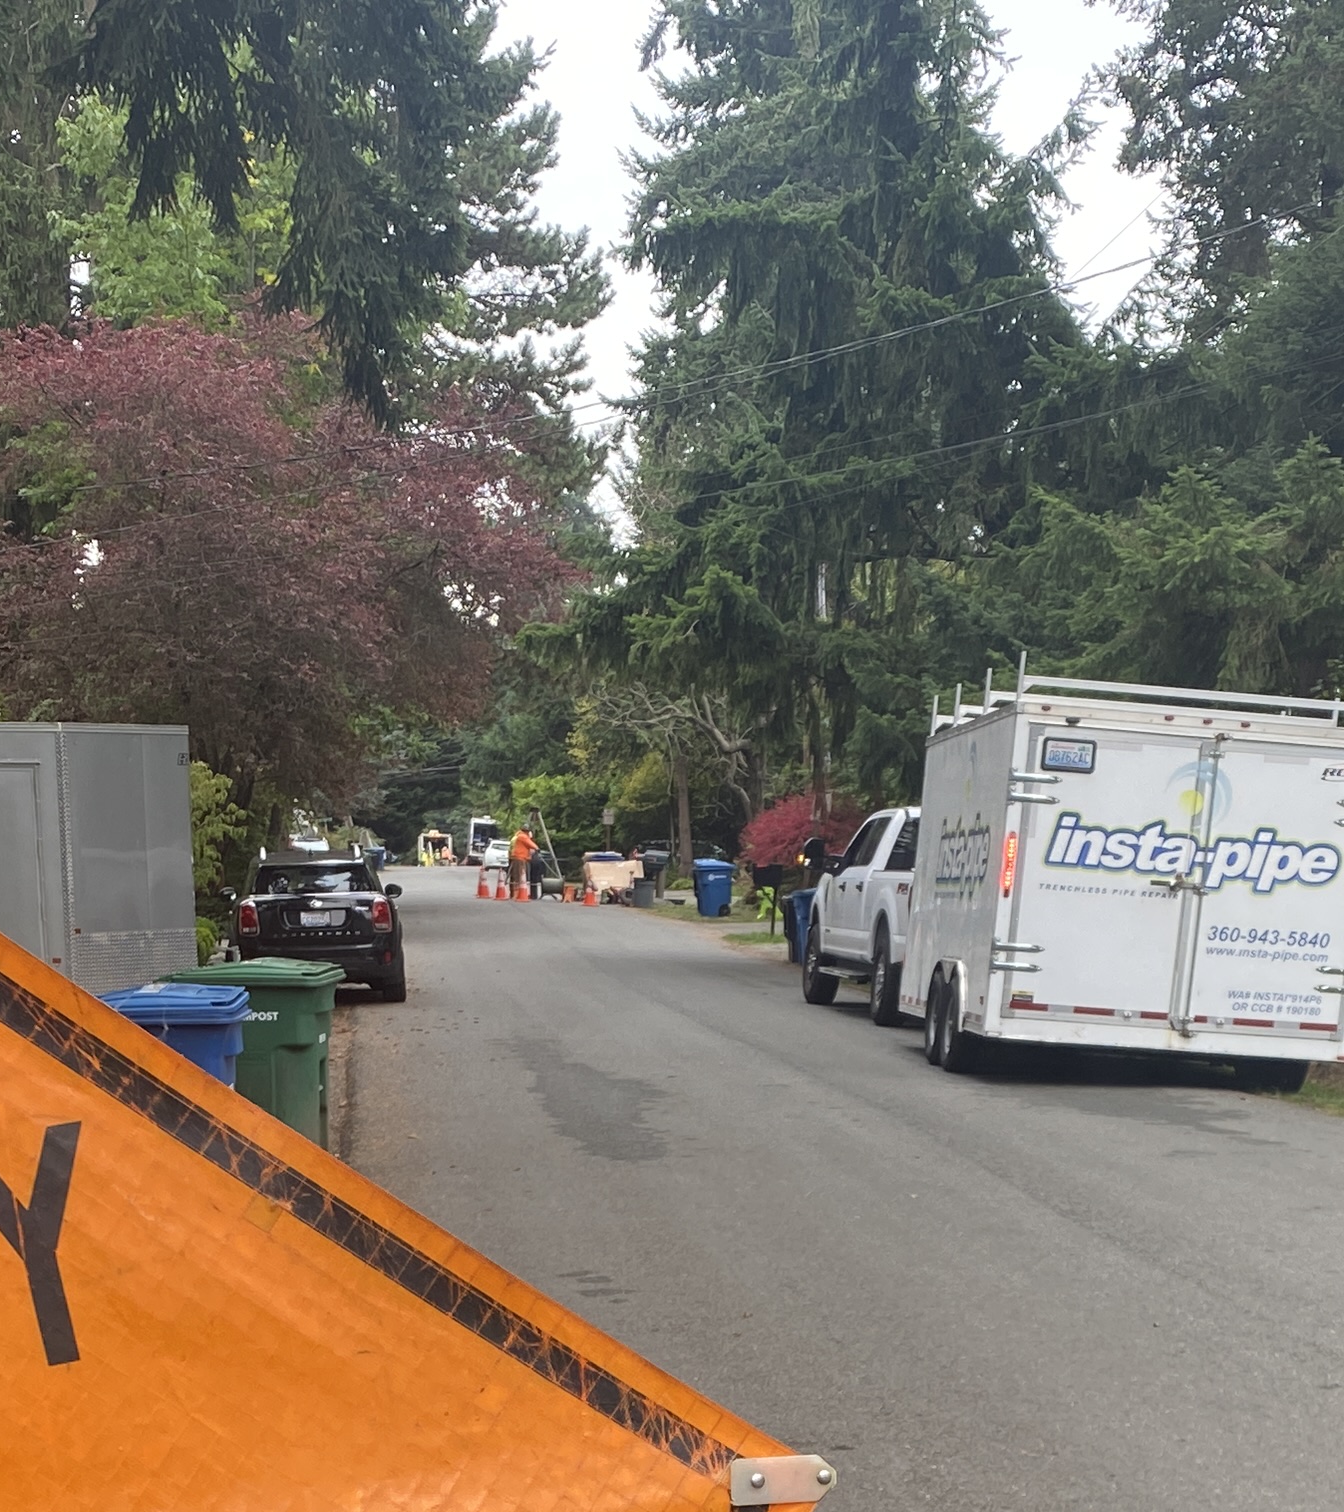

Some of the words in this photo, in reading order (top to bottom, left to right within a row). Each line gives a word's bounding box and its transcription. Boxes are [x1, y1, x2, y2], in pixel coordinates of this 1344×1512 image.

[1045, 811, 1341, 895] insta-pipe
[1039, 882, 1108, 895] TRENCHLESS
[1112, 888, 1136, 897] PIPE
[1141, 890, 1179, 900] REPAIR
[1207, 924, 1331, 949] 360-943-5840
[1205, 945, 1329, 963] www.insta-pipe.com
[1231, 1001, 1248, 1012] OR
[1251, 1003, 1274, 1014] CCB
